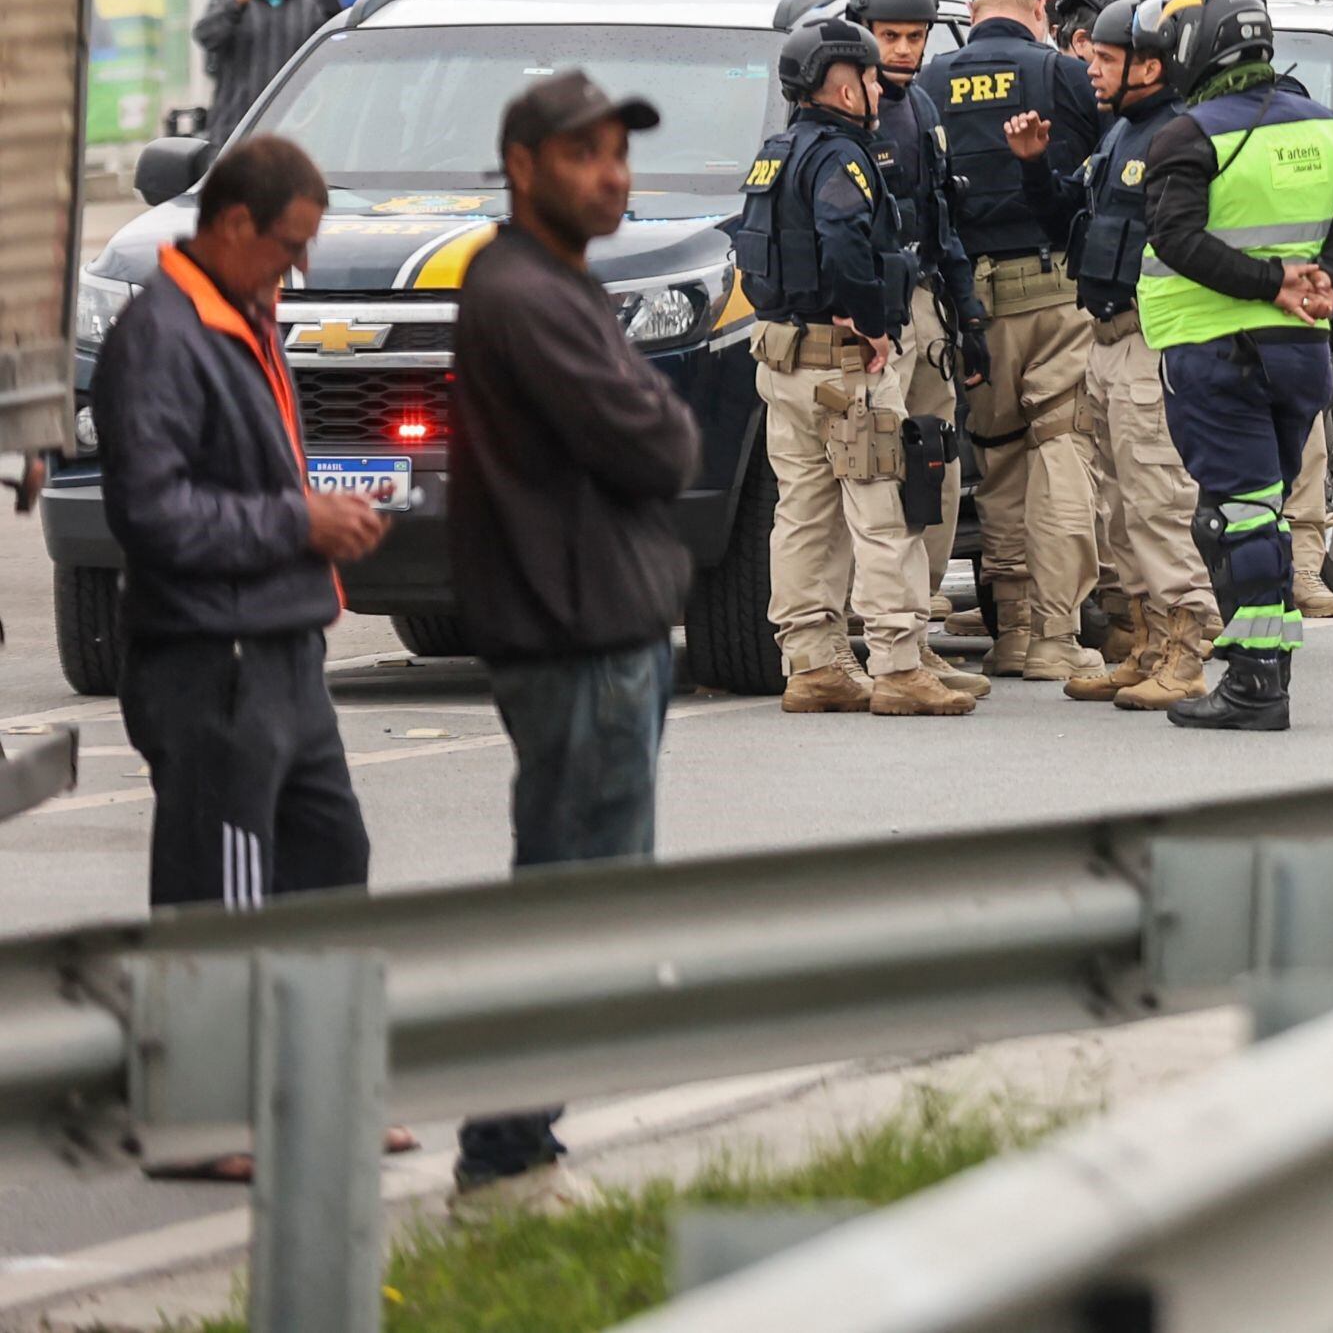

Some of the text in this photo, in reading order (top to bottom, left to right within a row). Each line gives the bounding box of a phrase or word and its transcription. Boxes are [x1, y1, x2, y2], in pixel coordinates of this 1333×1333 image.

[950, 72, 1015, 104] PRF
[1287, 145, 1320, 160] arteris
[746, 160, 781, 186] PRF
[317, 462, 343, 471] BRASIL
